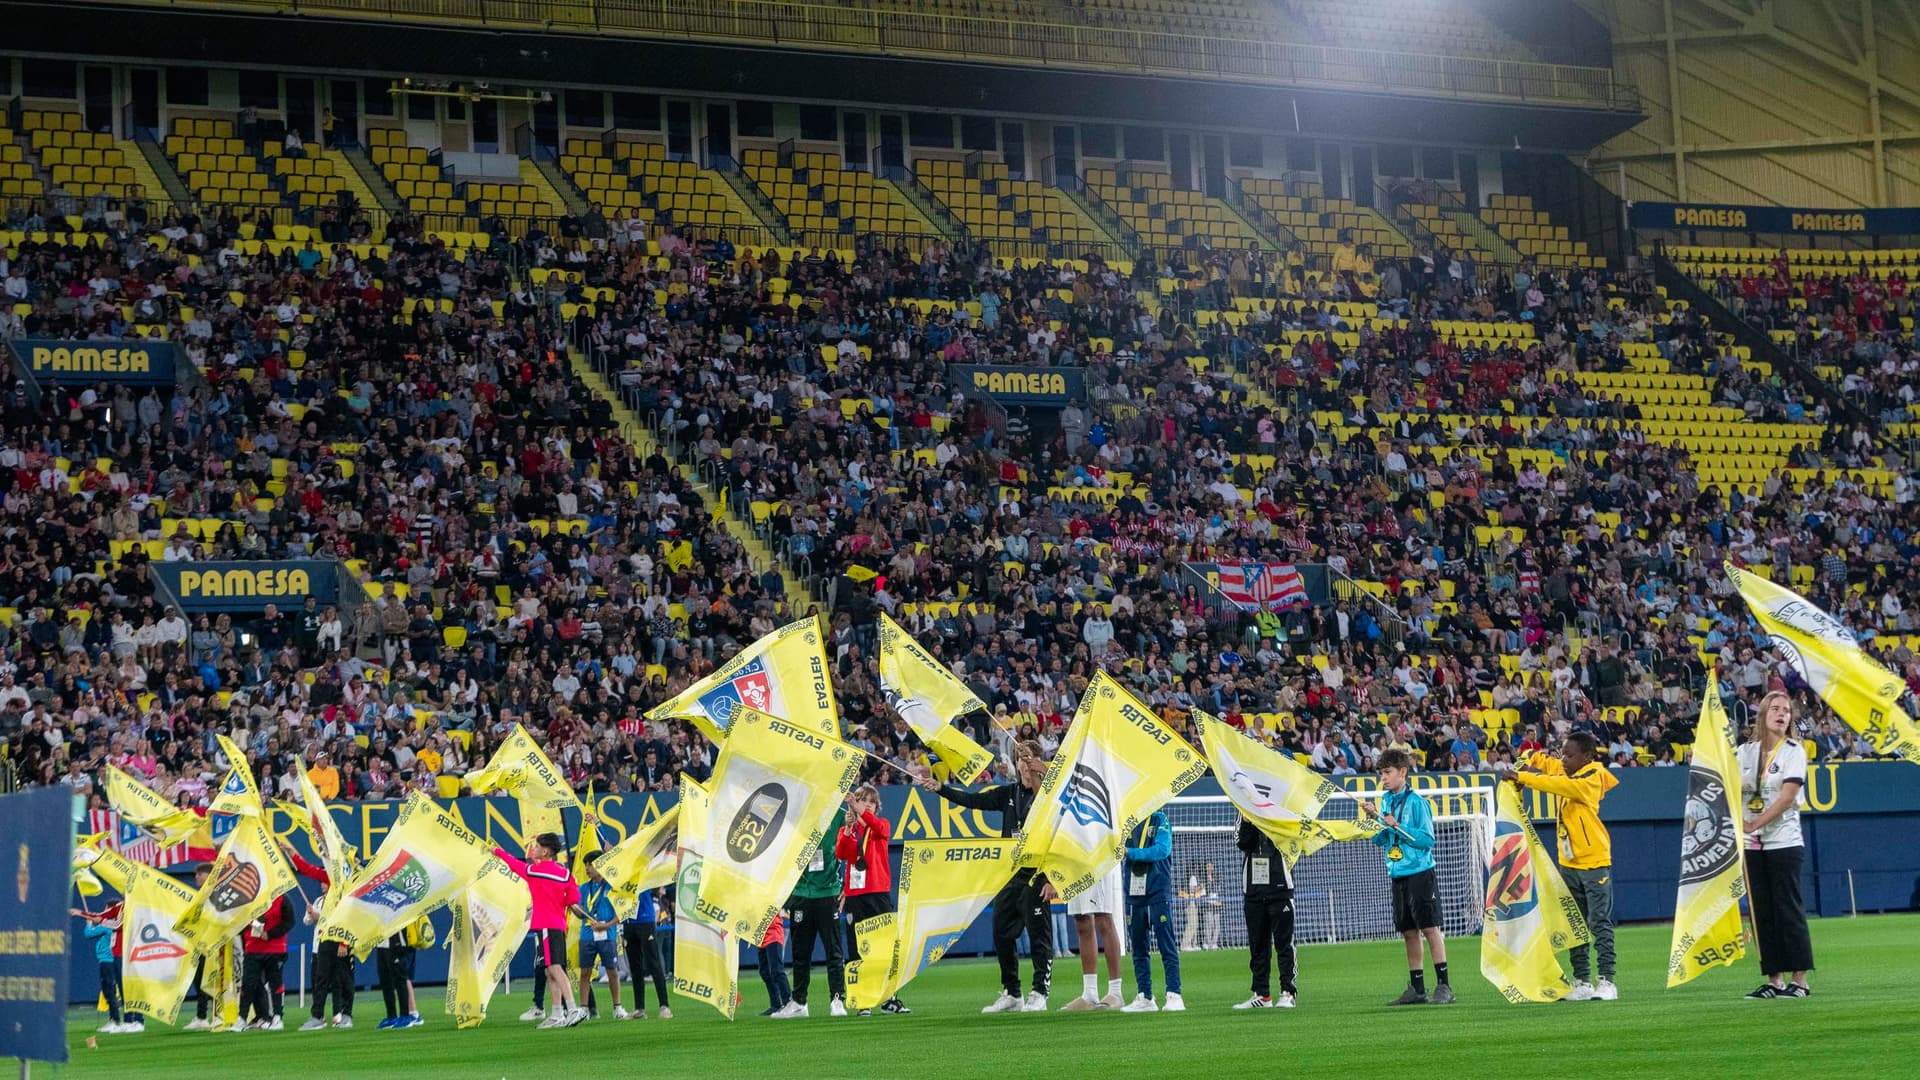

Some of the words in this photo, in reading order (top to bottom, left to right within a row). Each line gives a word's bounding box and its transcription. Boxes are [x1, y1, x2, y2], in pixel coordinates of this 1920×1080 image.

[1674, 208, 1747, 228] PAMESA
[1792, 213, 1865, 231] PAMESA
[33, 347, 150, 373] PAMESA
[973, 371, 1065, 395] PAMESA
[180, 569, 310, 597] PAMESA
